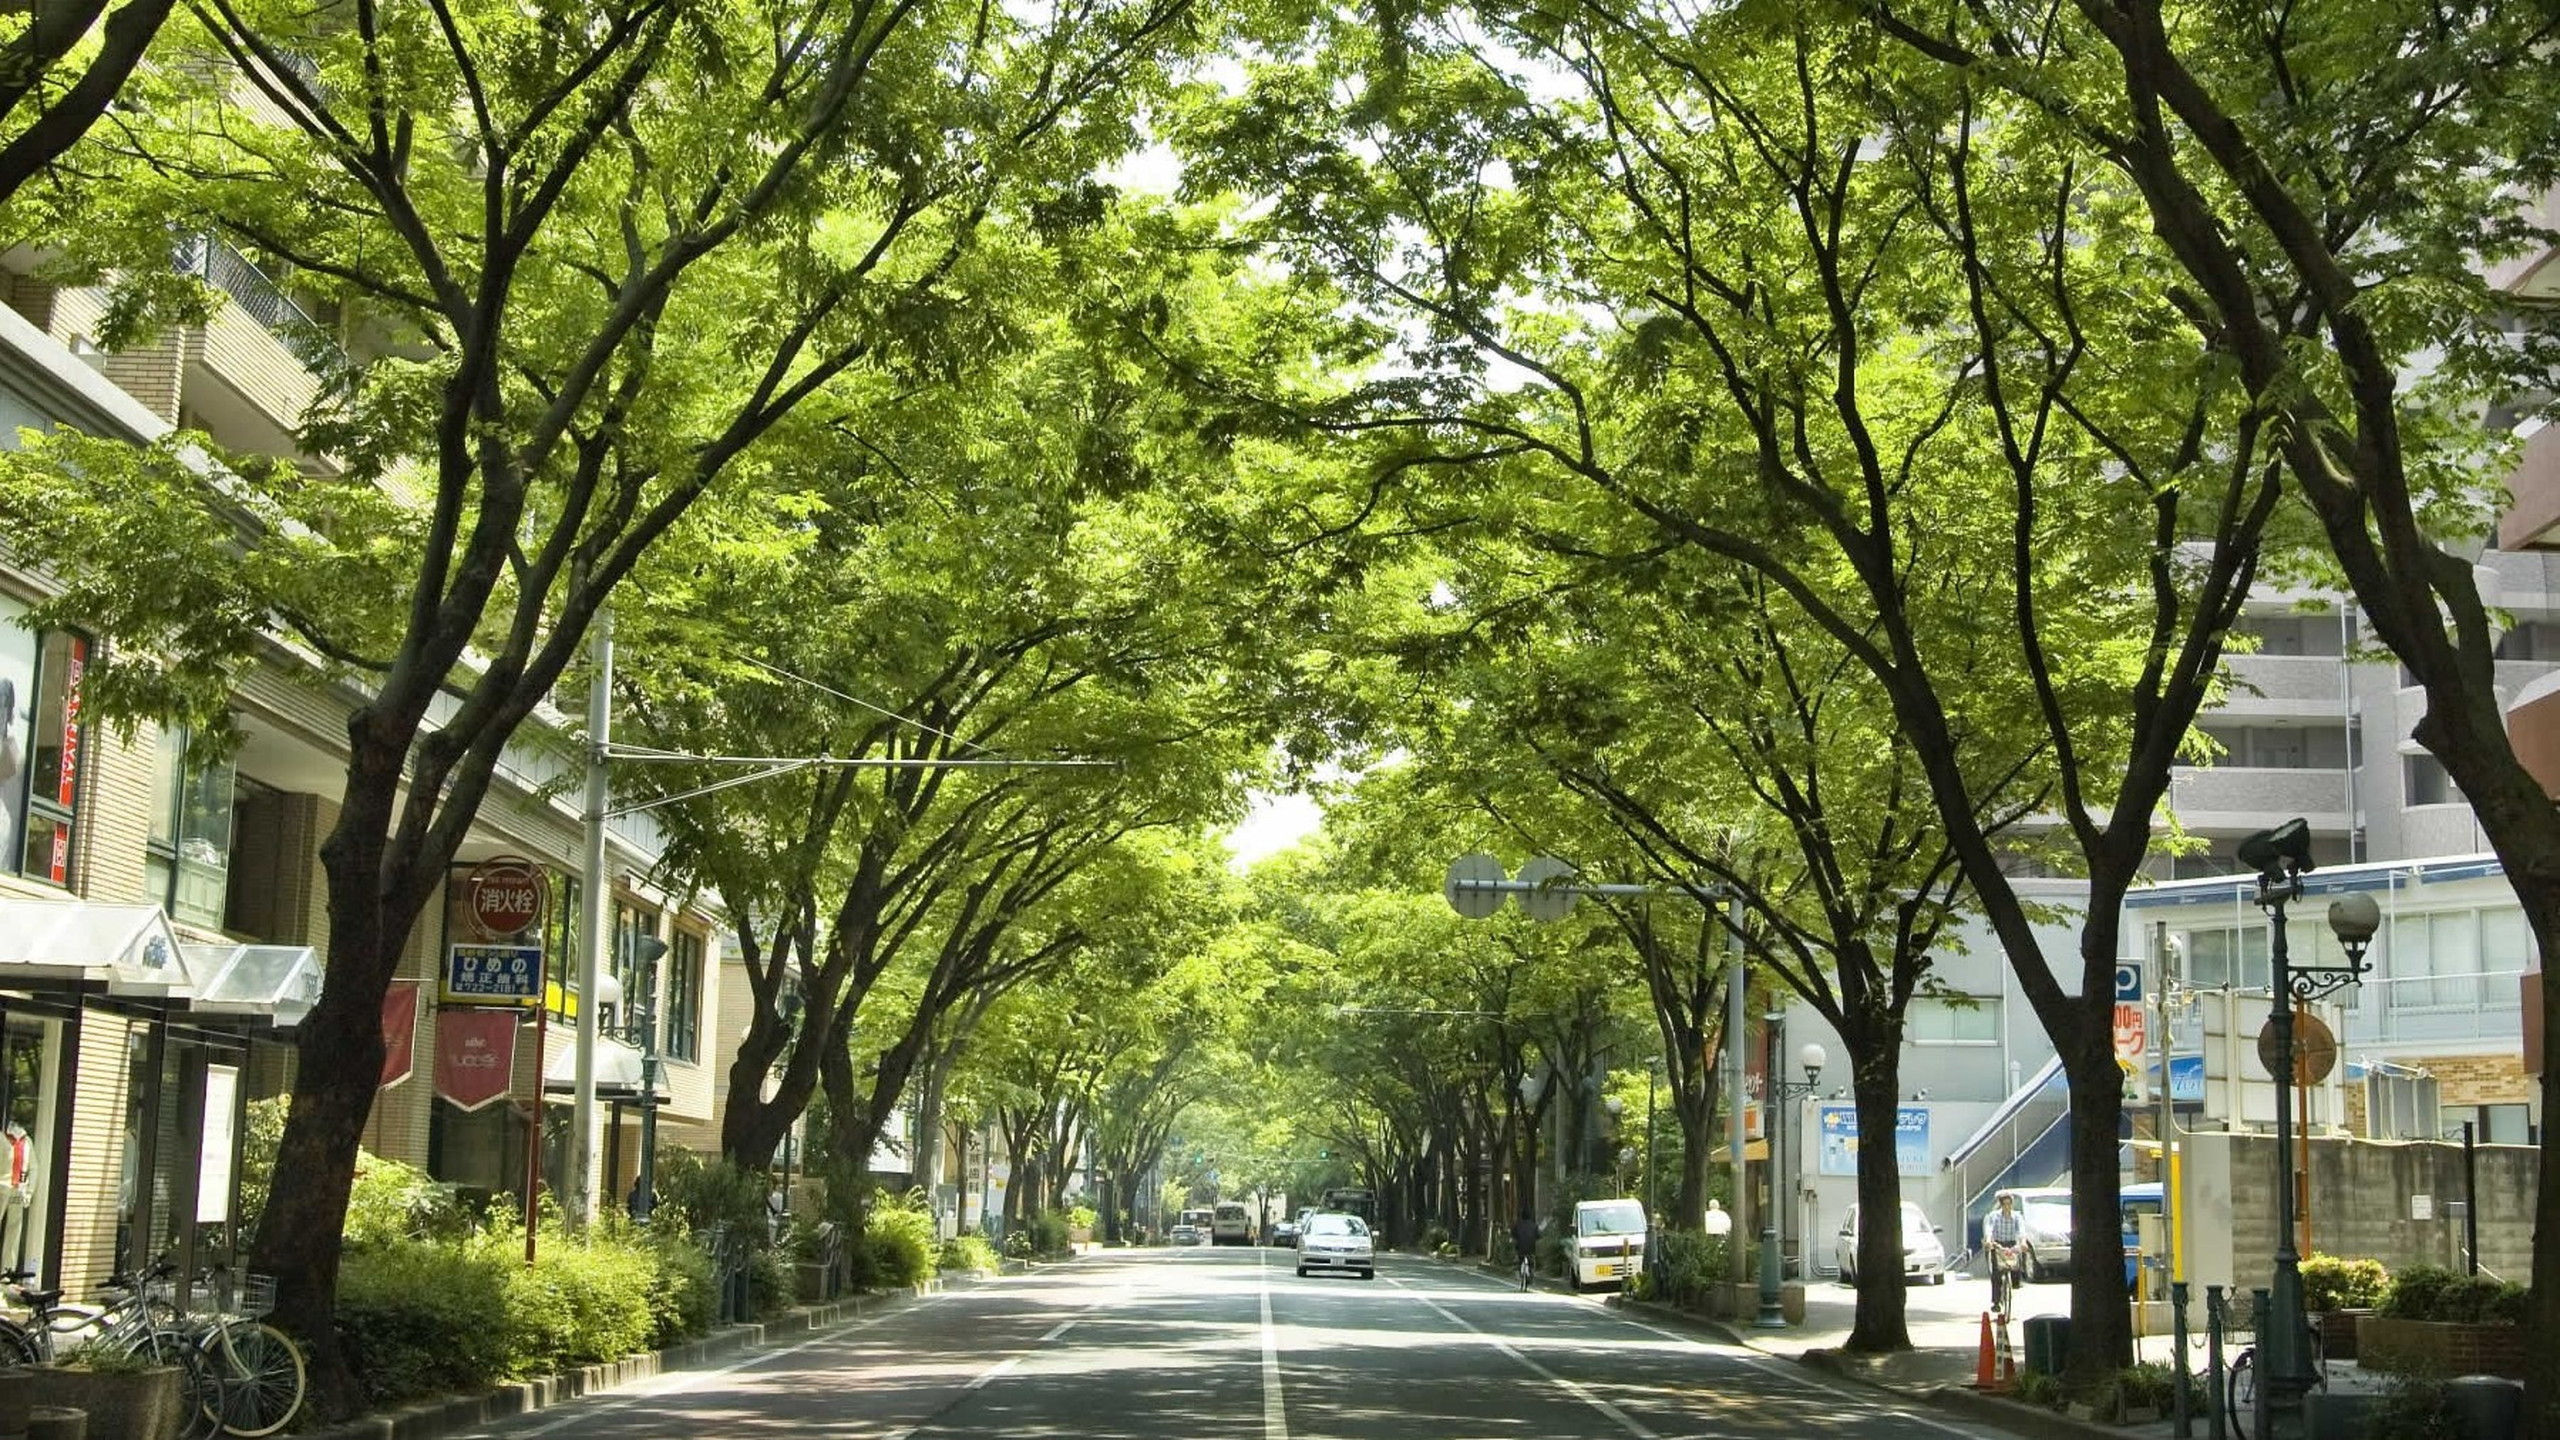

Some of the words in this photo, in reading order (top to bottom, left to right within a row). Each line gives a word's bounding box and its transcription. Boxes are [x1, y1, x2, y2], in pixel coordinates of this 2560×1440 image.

[480, 888, 534, 913] 消火栓
[463, 957, 528, 974] ひめの
[2115, 1005, 2142, 1028] 00円
[2115, 1031, 2145, 1055] ーク
